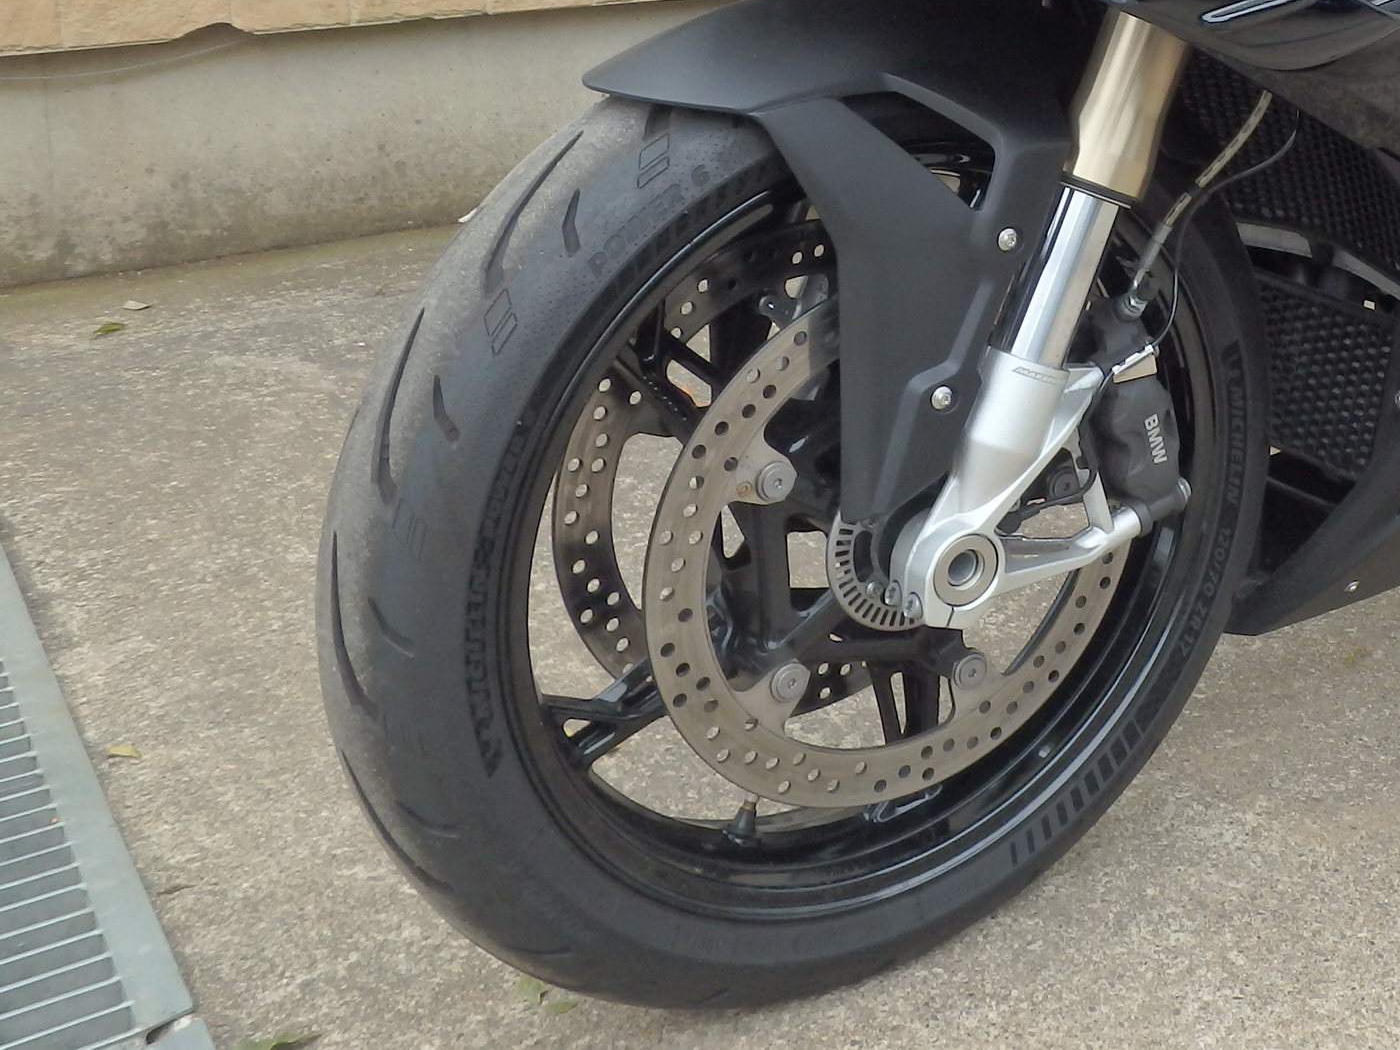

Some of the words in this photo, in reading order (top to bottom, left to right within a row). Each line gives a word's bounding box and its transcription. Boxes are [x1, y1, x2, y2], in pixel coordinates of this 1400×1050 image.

[587, 182, 689, 279] POWER
[690, 163, 711, 188] 6
[1143, 413, 1168, 465] BMW
[1226, 385, 1245, 505] MICHELIN
[1203, 527, 1232, 597] 120/70
